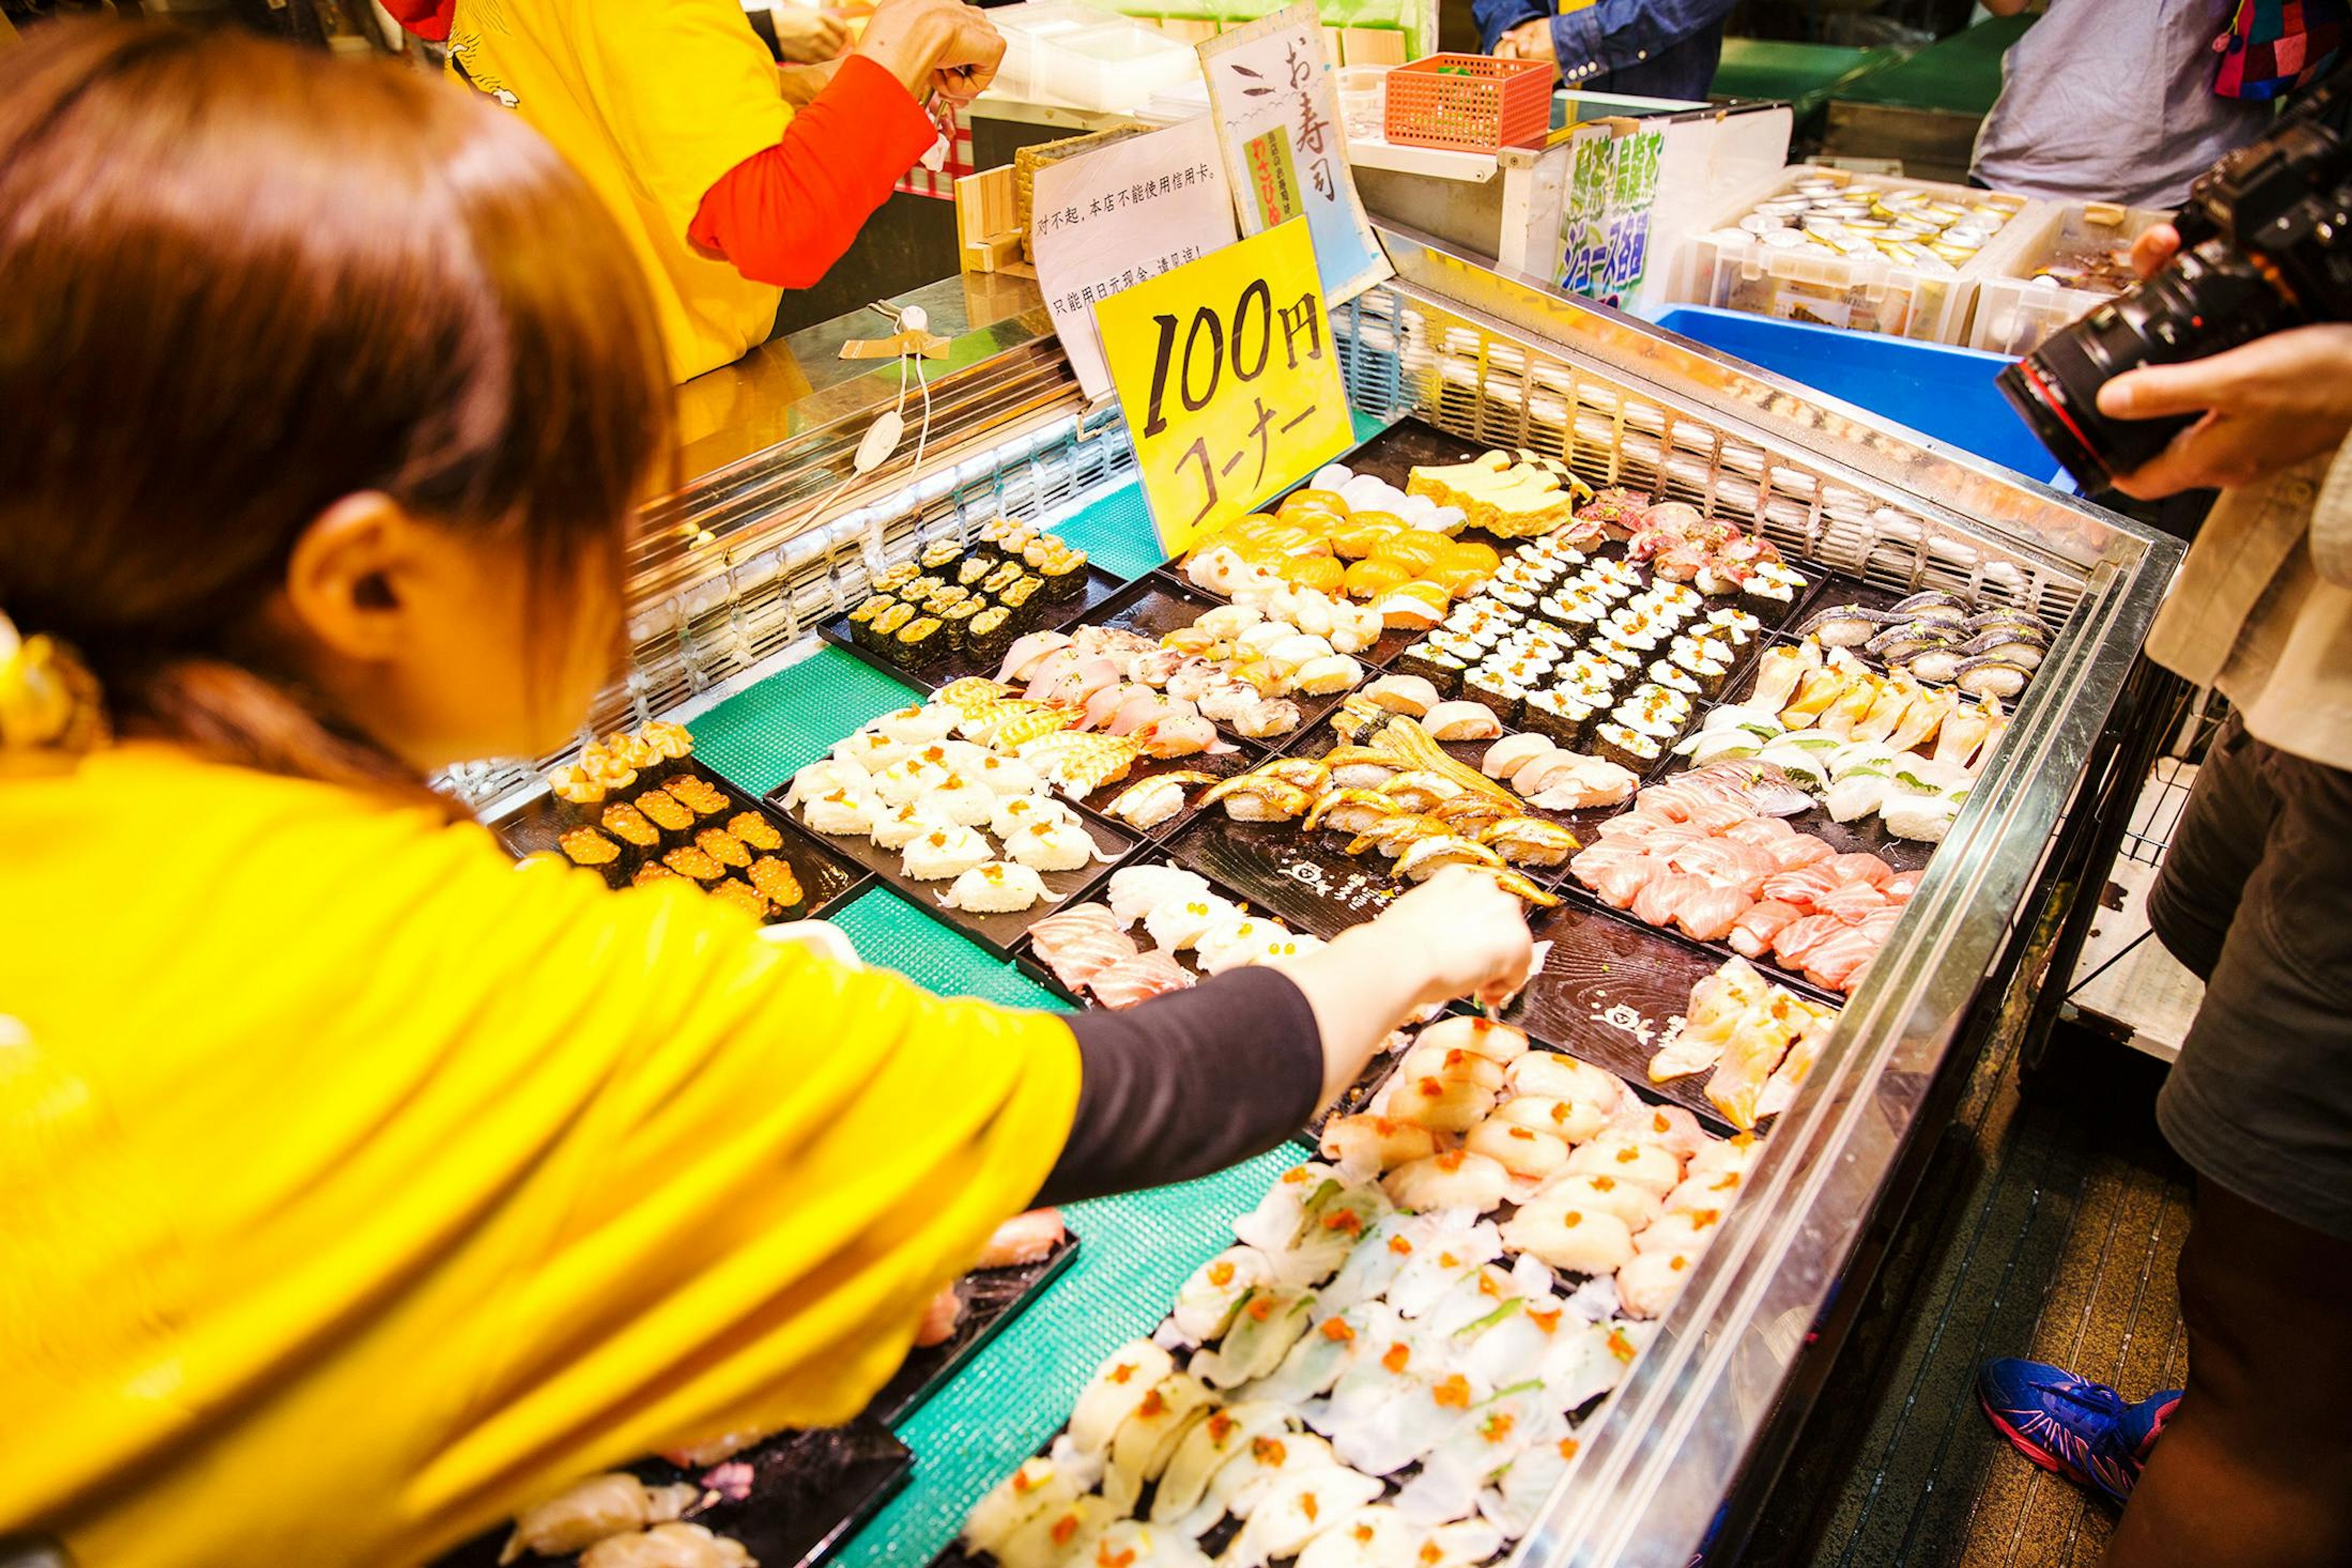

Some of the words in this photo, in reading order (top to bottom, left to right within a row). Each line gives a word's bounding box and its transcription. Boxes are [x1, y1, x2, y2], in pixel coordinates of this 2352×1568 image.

[1286, 37, 1334, 202] お寿司
[1144, 279, 1322, 439] 100円
[1175, 397, 1316, 527] コーナー
